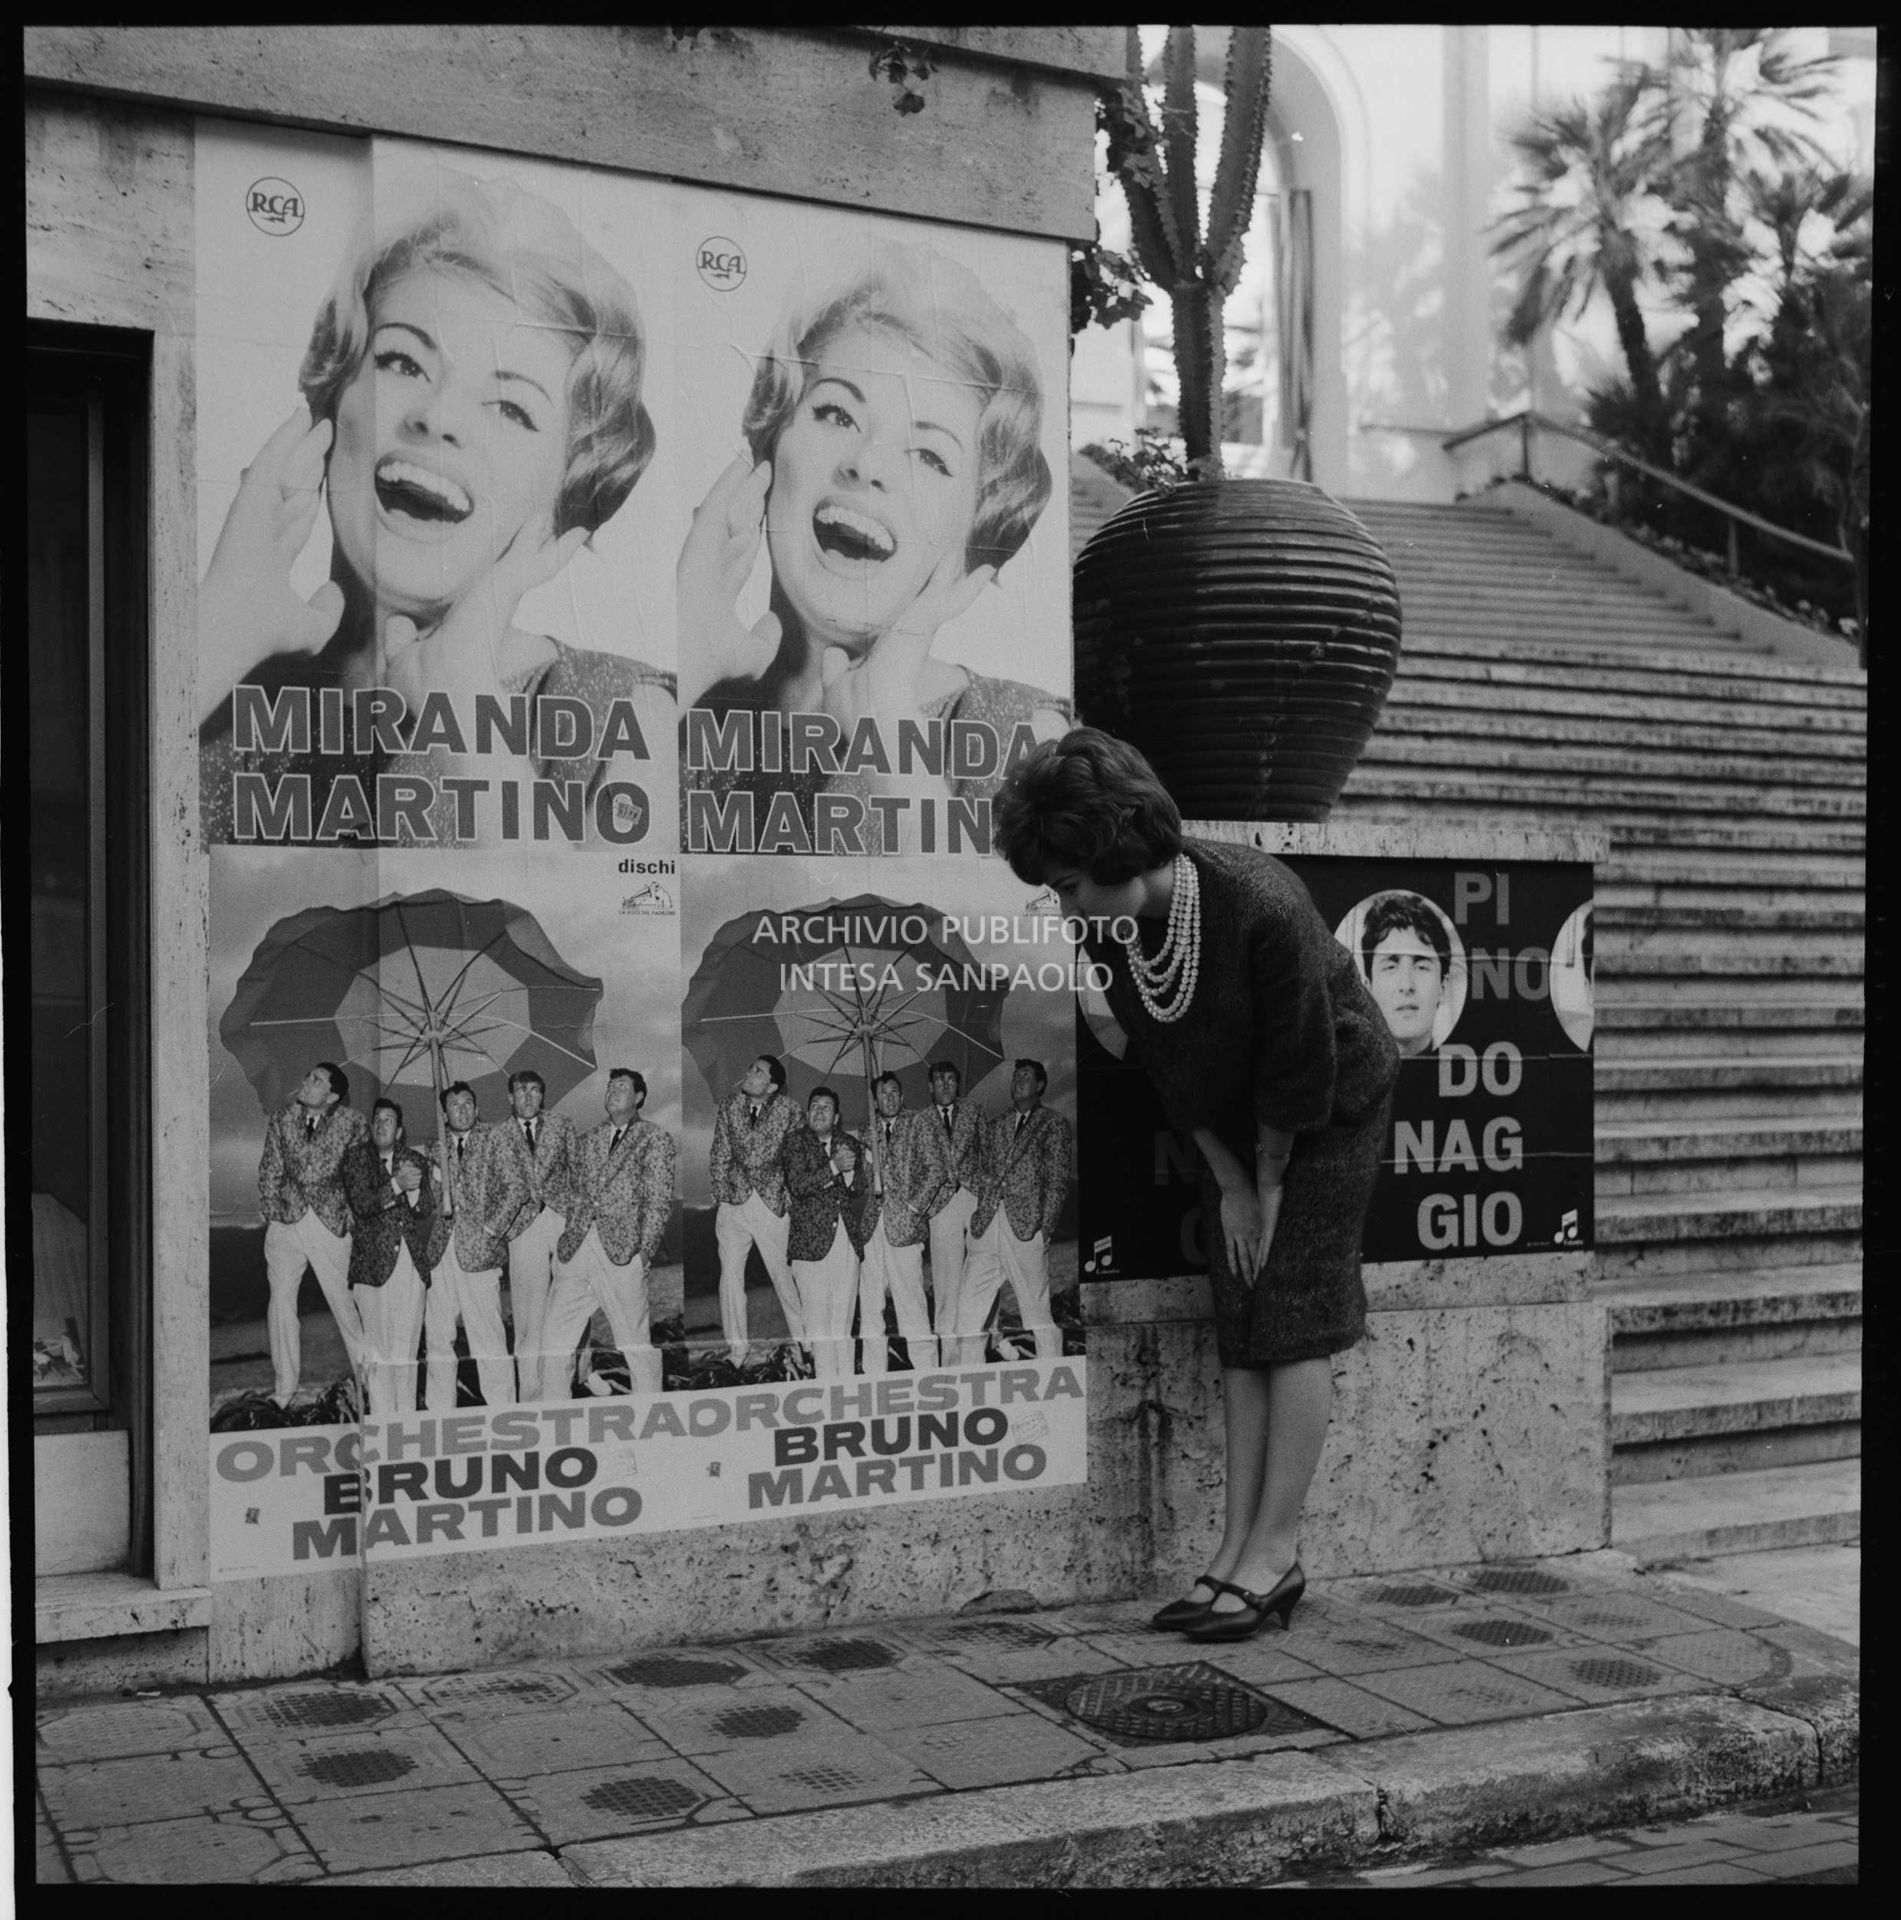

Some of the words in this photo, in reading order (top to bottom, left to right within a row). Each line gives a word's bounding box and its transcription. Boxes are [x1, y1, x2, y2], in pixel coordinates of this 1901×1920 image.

[250, 191, 303, 224] RCA
[699, 250, 746, 279] RCA
[233, 684, 652, 761] MIRANDA
[233, 772, 651, 845] MARTINO
[687, 790, 994, 857] MARTIN
[618, 858, 675, 875] dischi
[1453, 872, 1511, 926] PI
[1470, 946, 1550, 1002] NO
[1438, 1040, 1523, 1098] DO
[1393, 1116, 1524, 1175] NAG
[1416, 1190, 1523, 1251] GIO
[688, 1366, 1084, 1438] ORCHESTRA
[216, 1400, 689, 1483] ORCHESTRA
[774, 1407, 1009, 1467] BRUNO
[323, 1446, 599, 1515] BRUNO
[747, 1443, 1048, 1510] MARTINO
[292, 1486, 643, 1561] MARTINO
